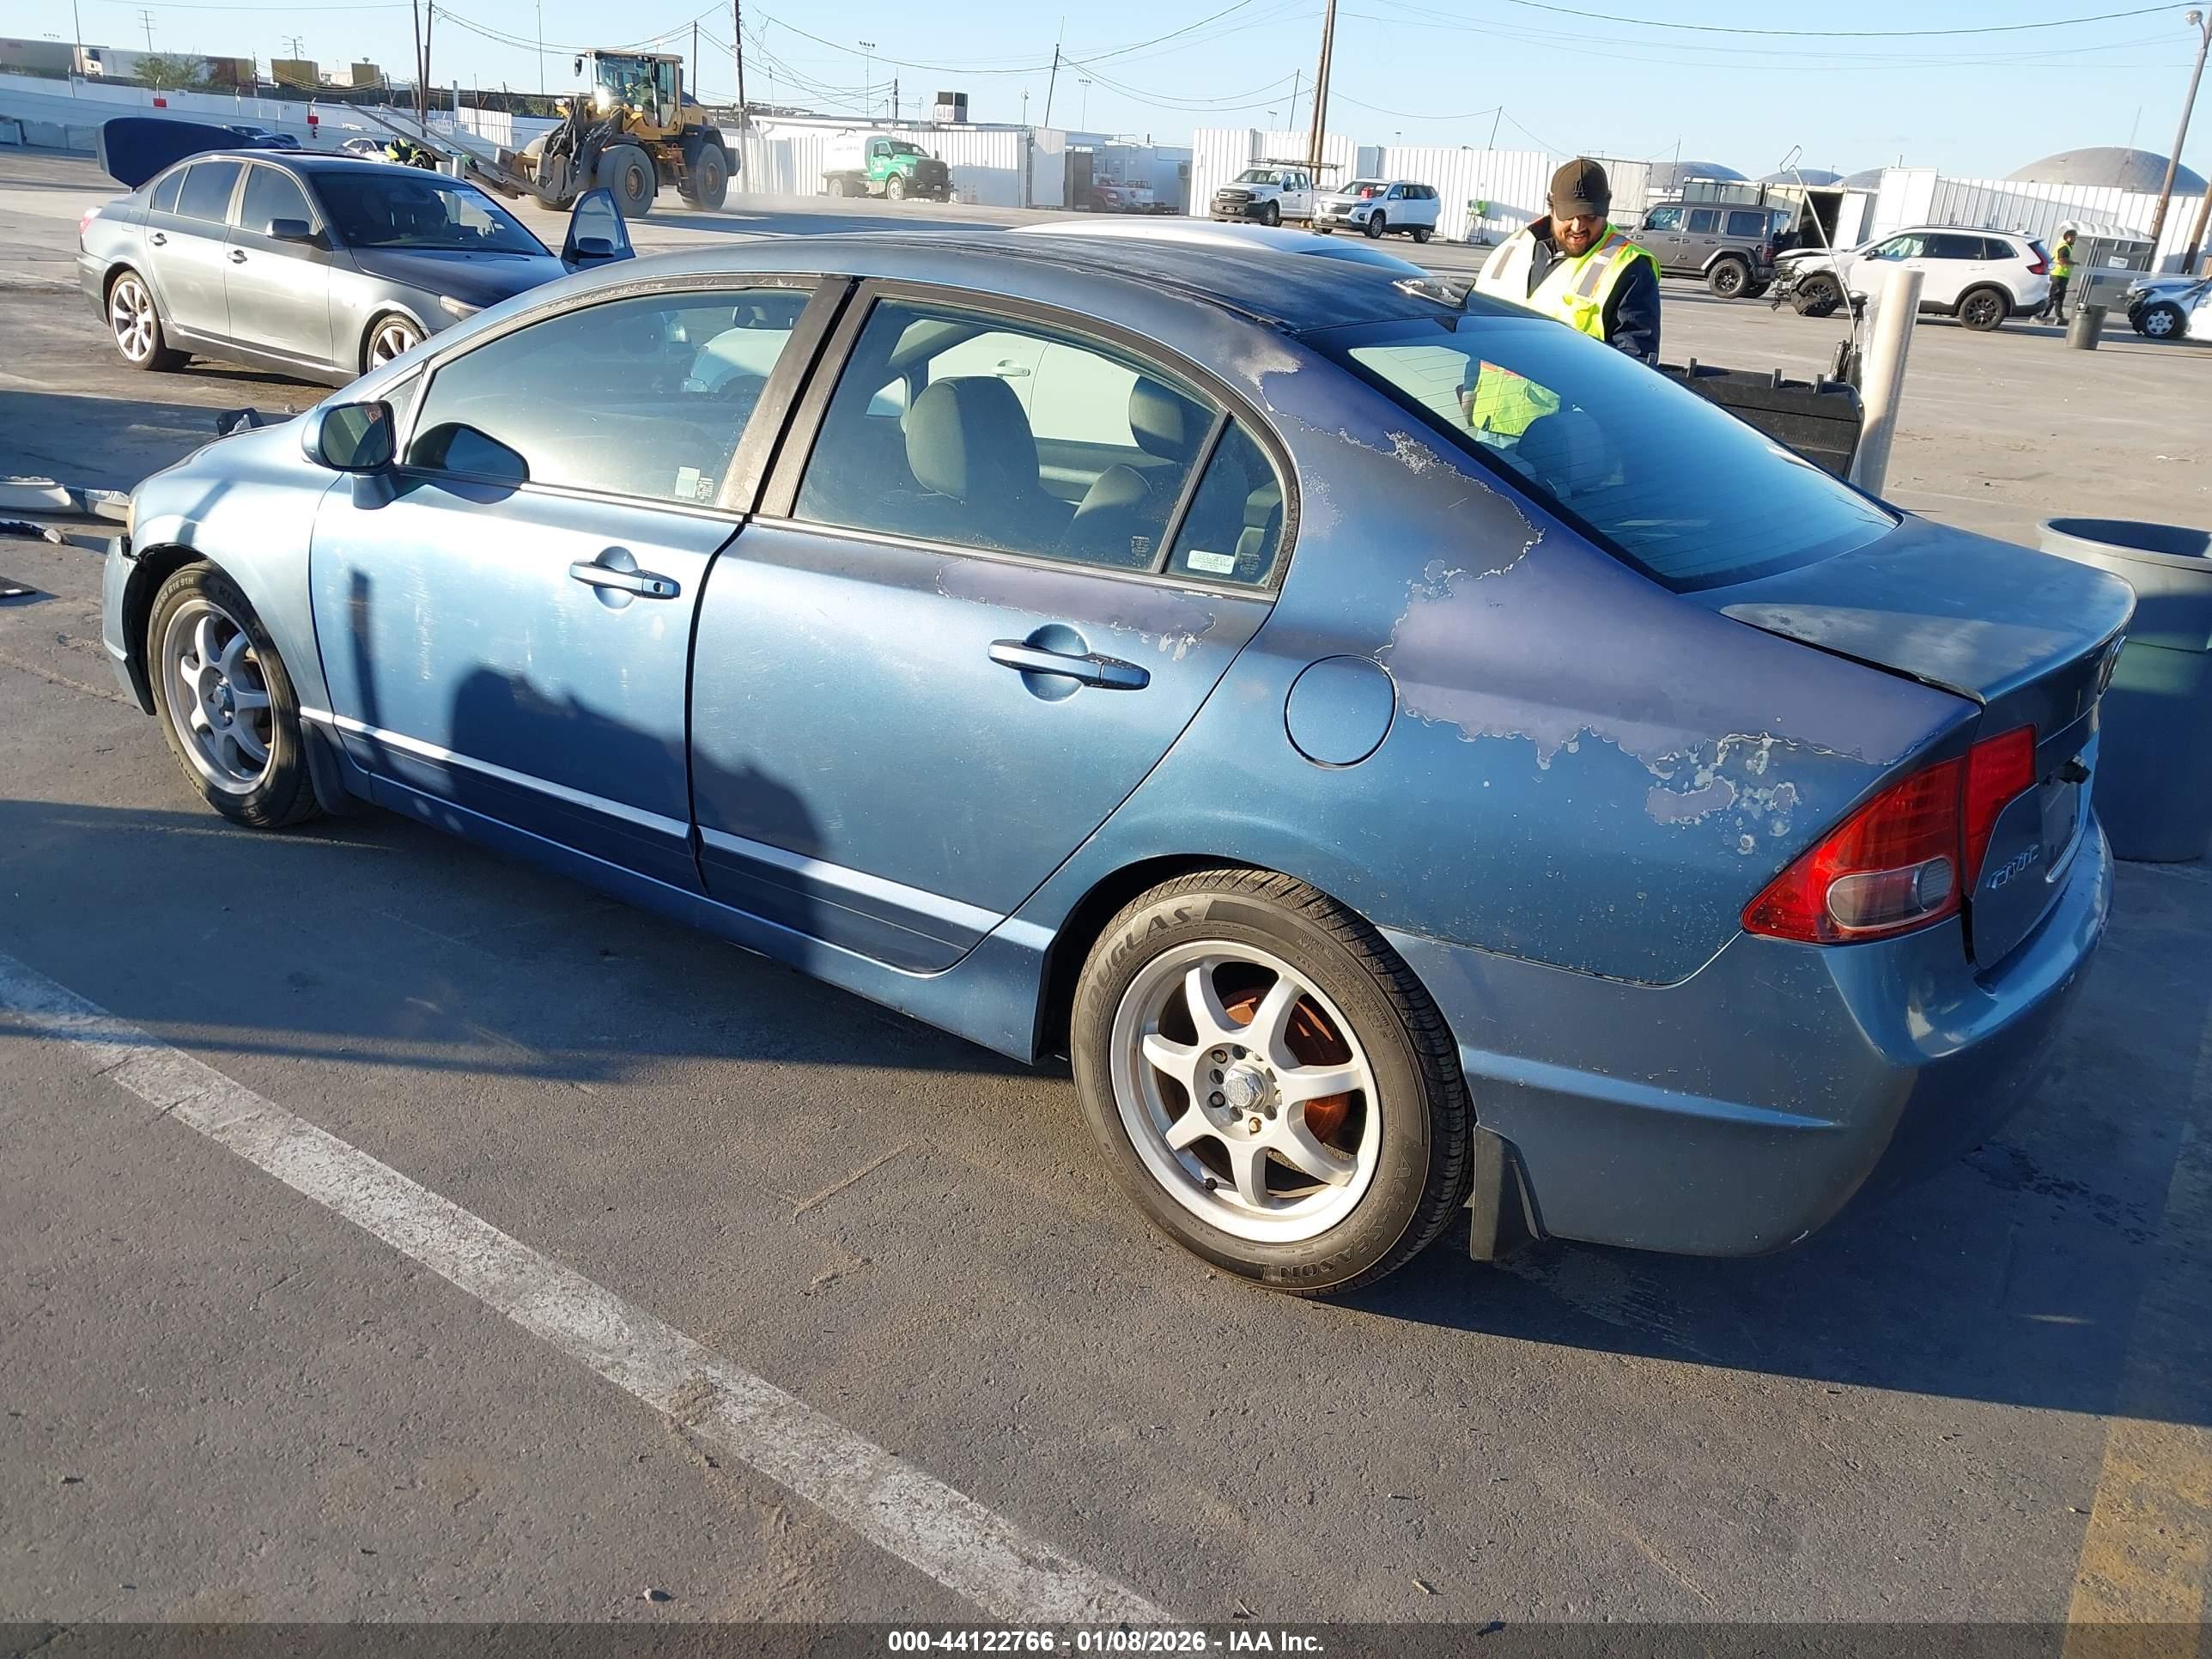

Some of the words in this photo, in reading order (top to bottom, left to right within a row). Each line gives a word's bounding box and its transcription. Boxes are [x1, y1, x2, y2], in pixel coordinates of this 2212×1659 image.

[1572, 179, 1587, 199] LA
[1079, 905, 1193, 1036] DOUGLAS
[1279, 1150, 1412, 1279] ALL-SEASON
